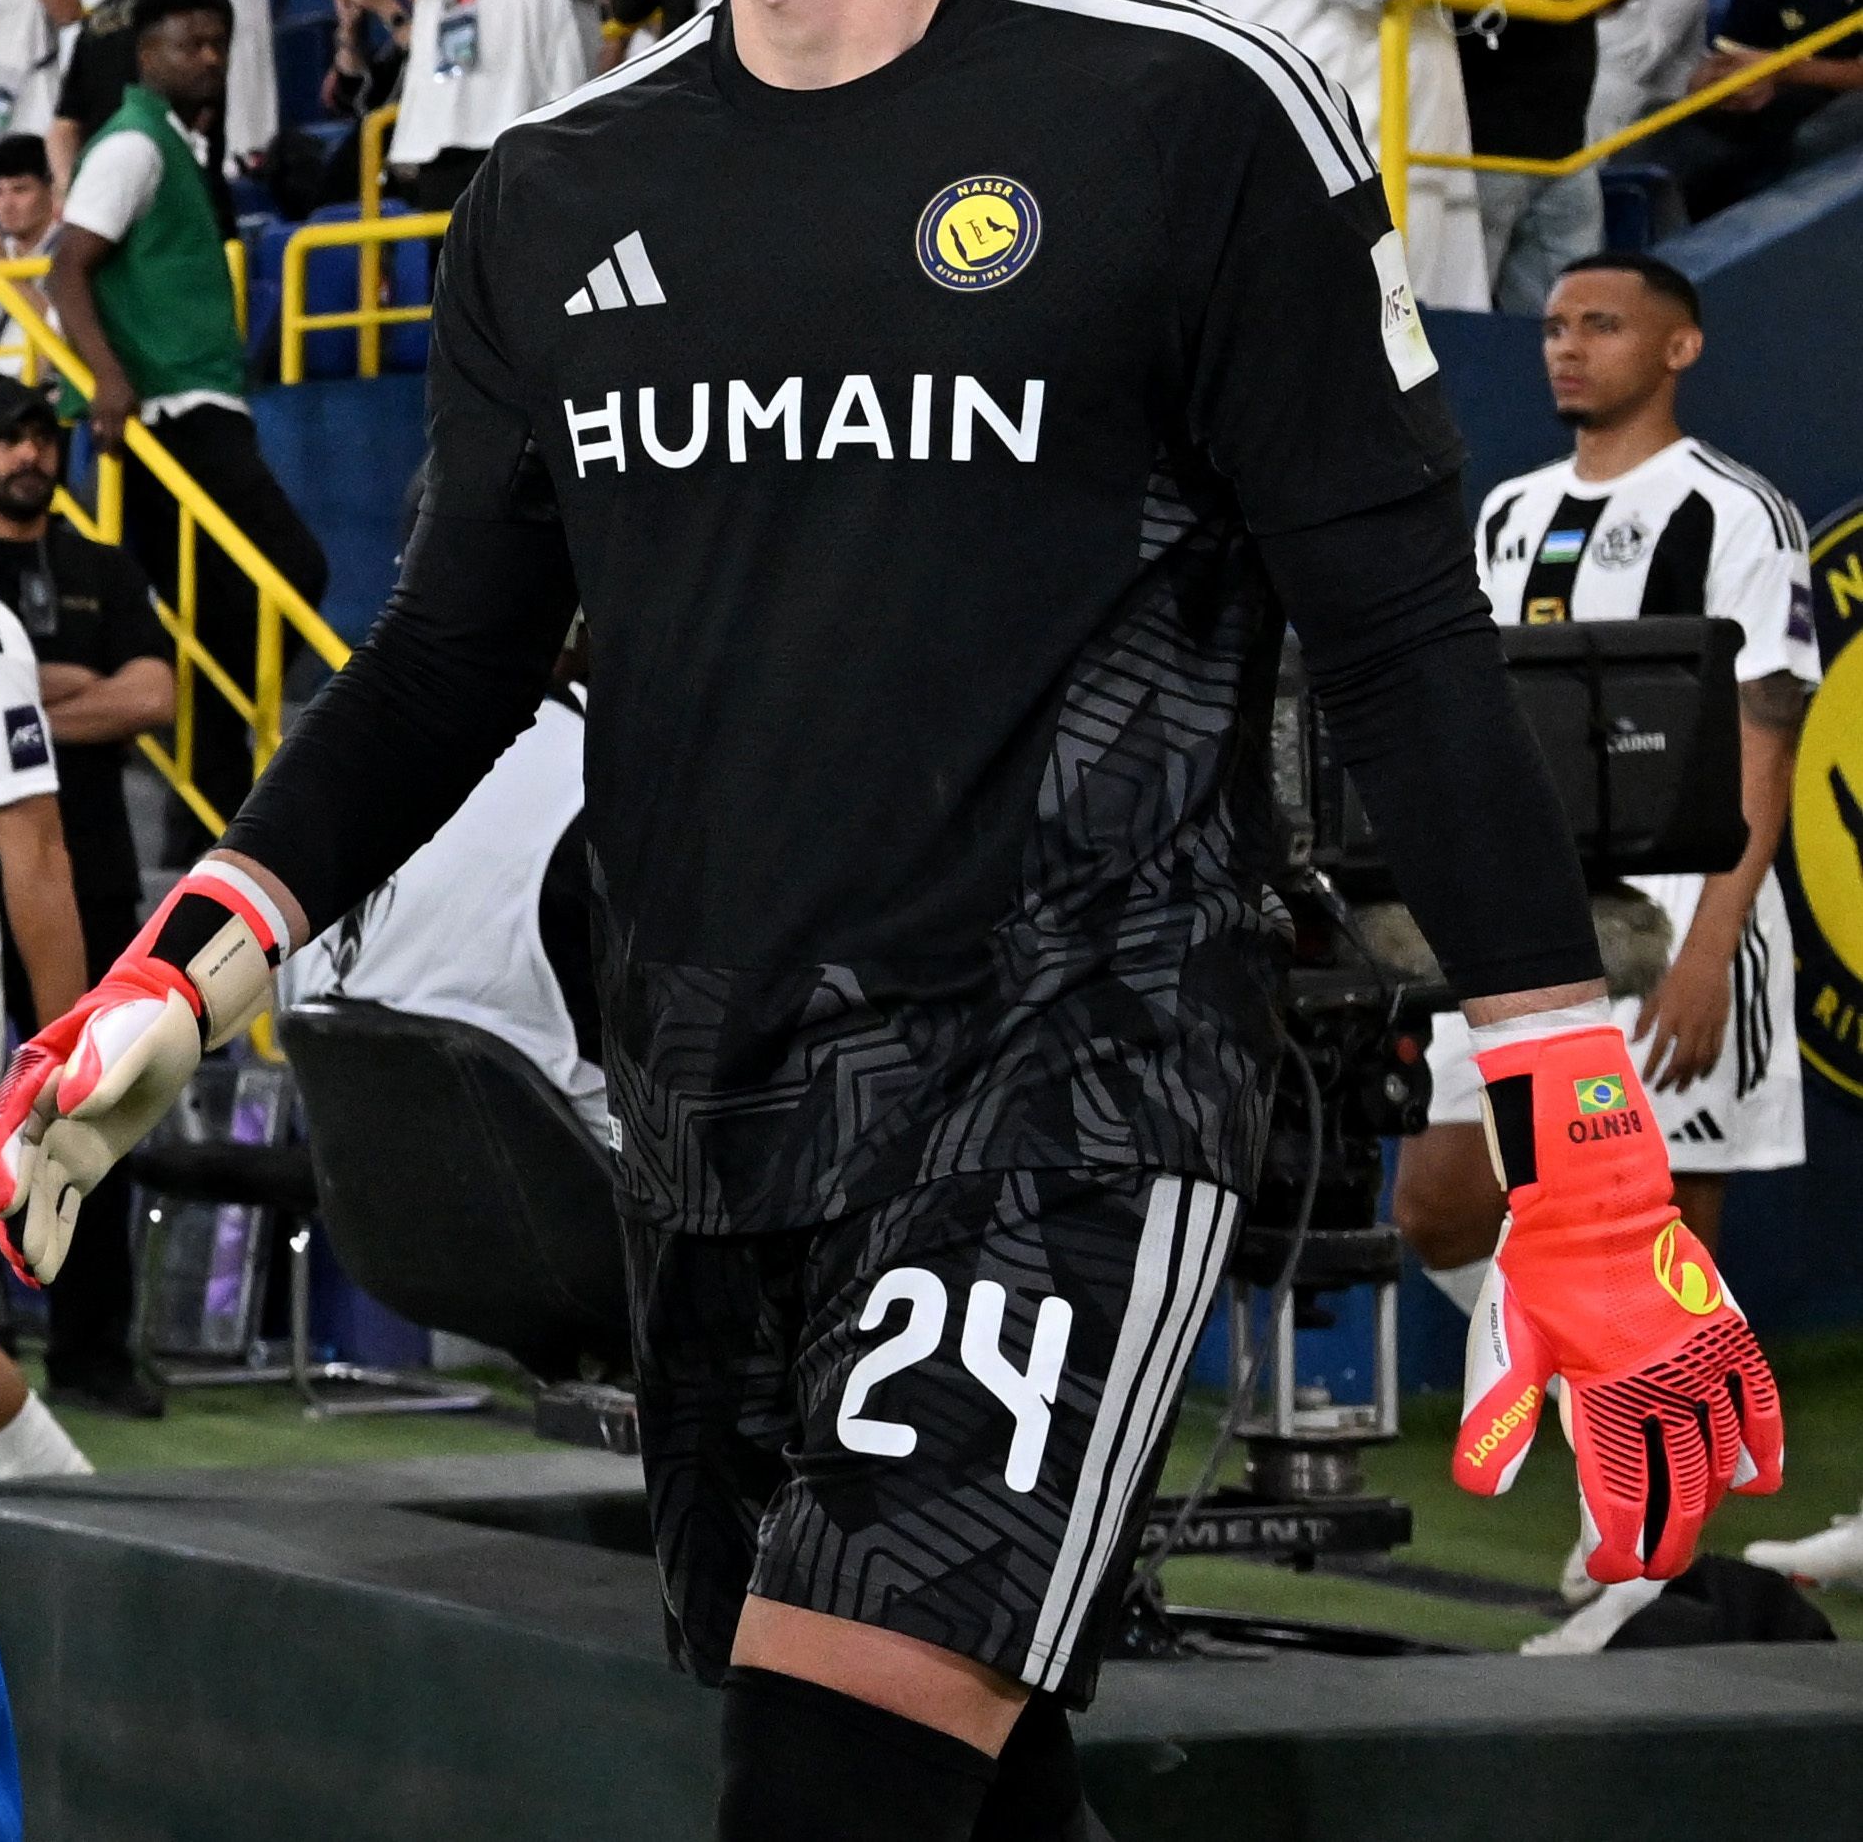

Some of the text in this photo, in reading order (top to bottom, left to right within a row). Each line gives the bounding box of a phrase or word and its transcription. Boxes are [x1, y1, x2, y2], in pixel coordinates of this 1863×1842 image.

[956, 181, 1014, 198] NASSR
[934, 263, 977, 284] RIYADH
[1385, 284, 1411, 329] AFC
[563, 373, 1046, 479] HUMAIN
[1567, 1109, 1643, 1144] BENTO
[836, 1266, 1074, 1494] 24
[1464, 1383, 1541, 1468] uhlsport
